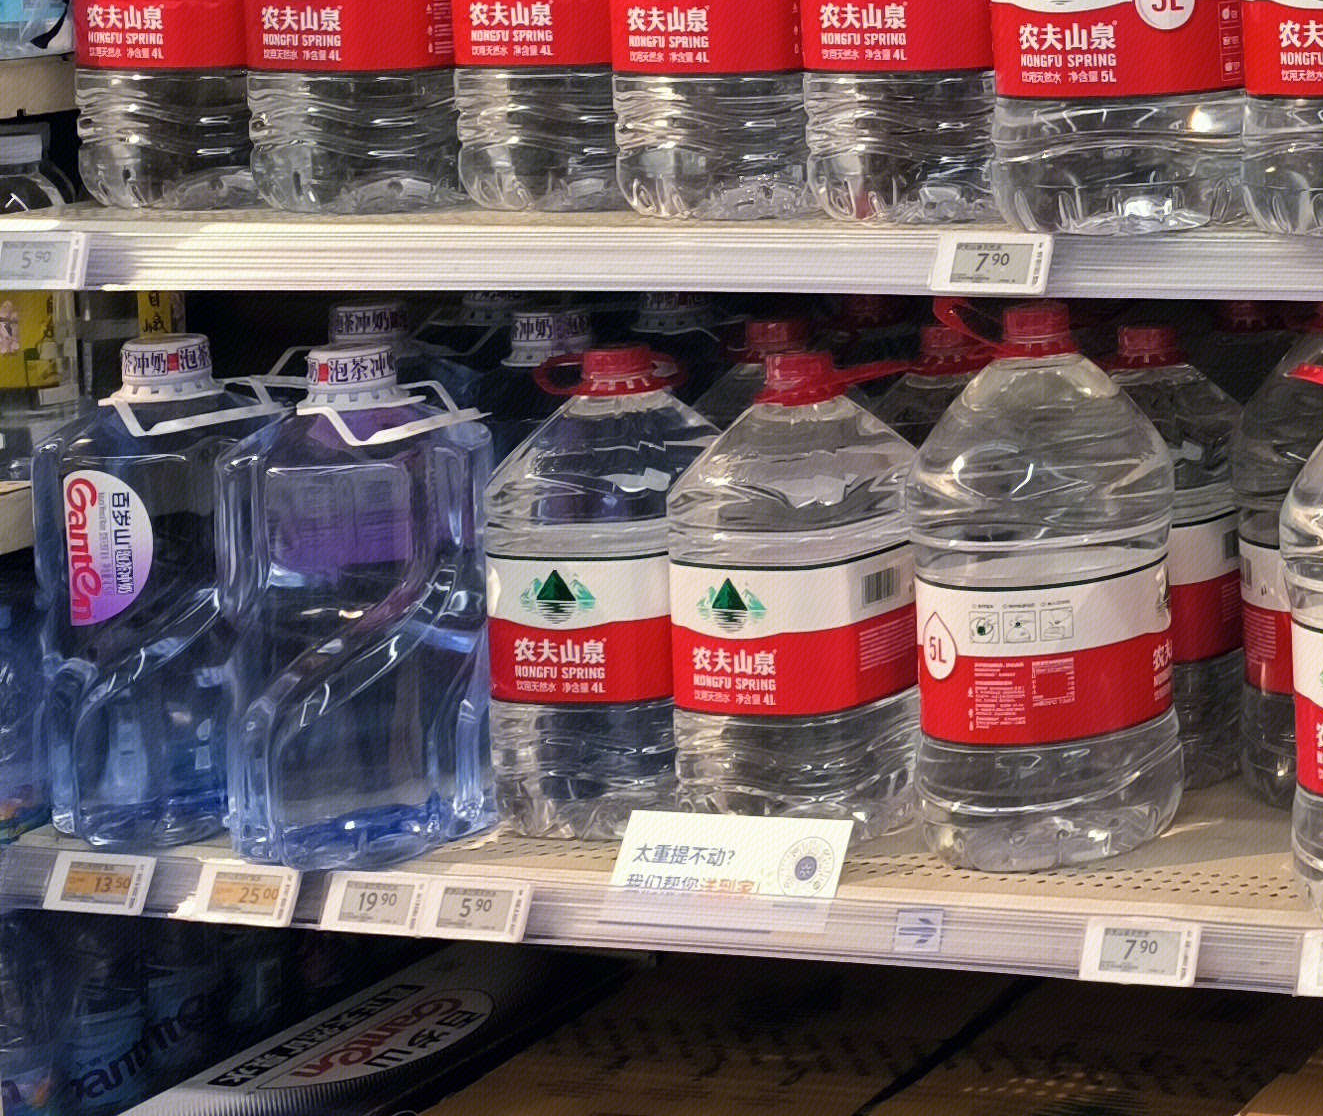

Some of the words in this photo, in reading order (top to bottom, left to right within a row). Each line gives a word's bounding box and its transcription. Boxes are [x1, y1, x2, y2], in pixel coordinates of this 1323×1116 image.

[87, 4, 163, 31] 农夫山泉
[262, 6, 341, 32] 农夫山泉
[469, 1, 552, 27] 农夫山泉
[627, 6, 708, 33] 农夫山泉
[819, 2, 907, 30] 农夫山泉
[88, 30, 122, 45] NONGFU
[126, 32, 164, 46] SPRING
[263, 33, 298, 47] NONGFU
[301, 33, 341, 48] SPRING
[471, 29, 509, 43] NONGFU
[512, 28, 553, 42] SPRING
[629, 34, 665, 48] NONGFU
[668, 34, 709, 49] SPRING
[821, 32, 860, 45] NONGFU
[864, 32, 906, 46] SPRING
[1019, 22, 1117, 51] 农夫山泉
[1020, 54, 1062, 68] NONGFU
[1067, 53, 1117, 67] SPRING
[112, 492, 131, 546] 百岁山
[67, 478, 101, 619] Ganten
[514, 638, 606, 664] 农夫山泉
[692, 647, 776, 675] 农夫山泉
[929, 639, 947, 664] 5L
[515, 665, 558, 679] NONGFU
[562, 666, 605, 679] SPRING
[693, 675, 732, 690] NONGFU
[735, 677, 776, 691] SPRING
